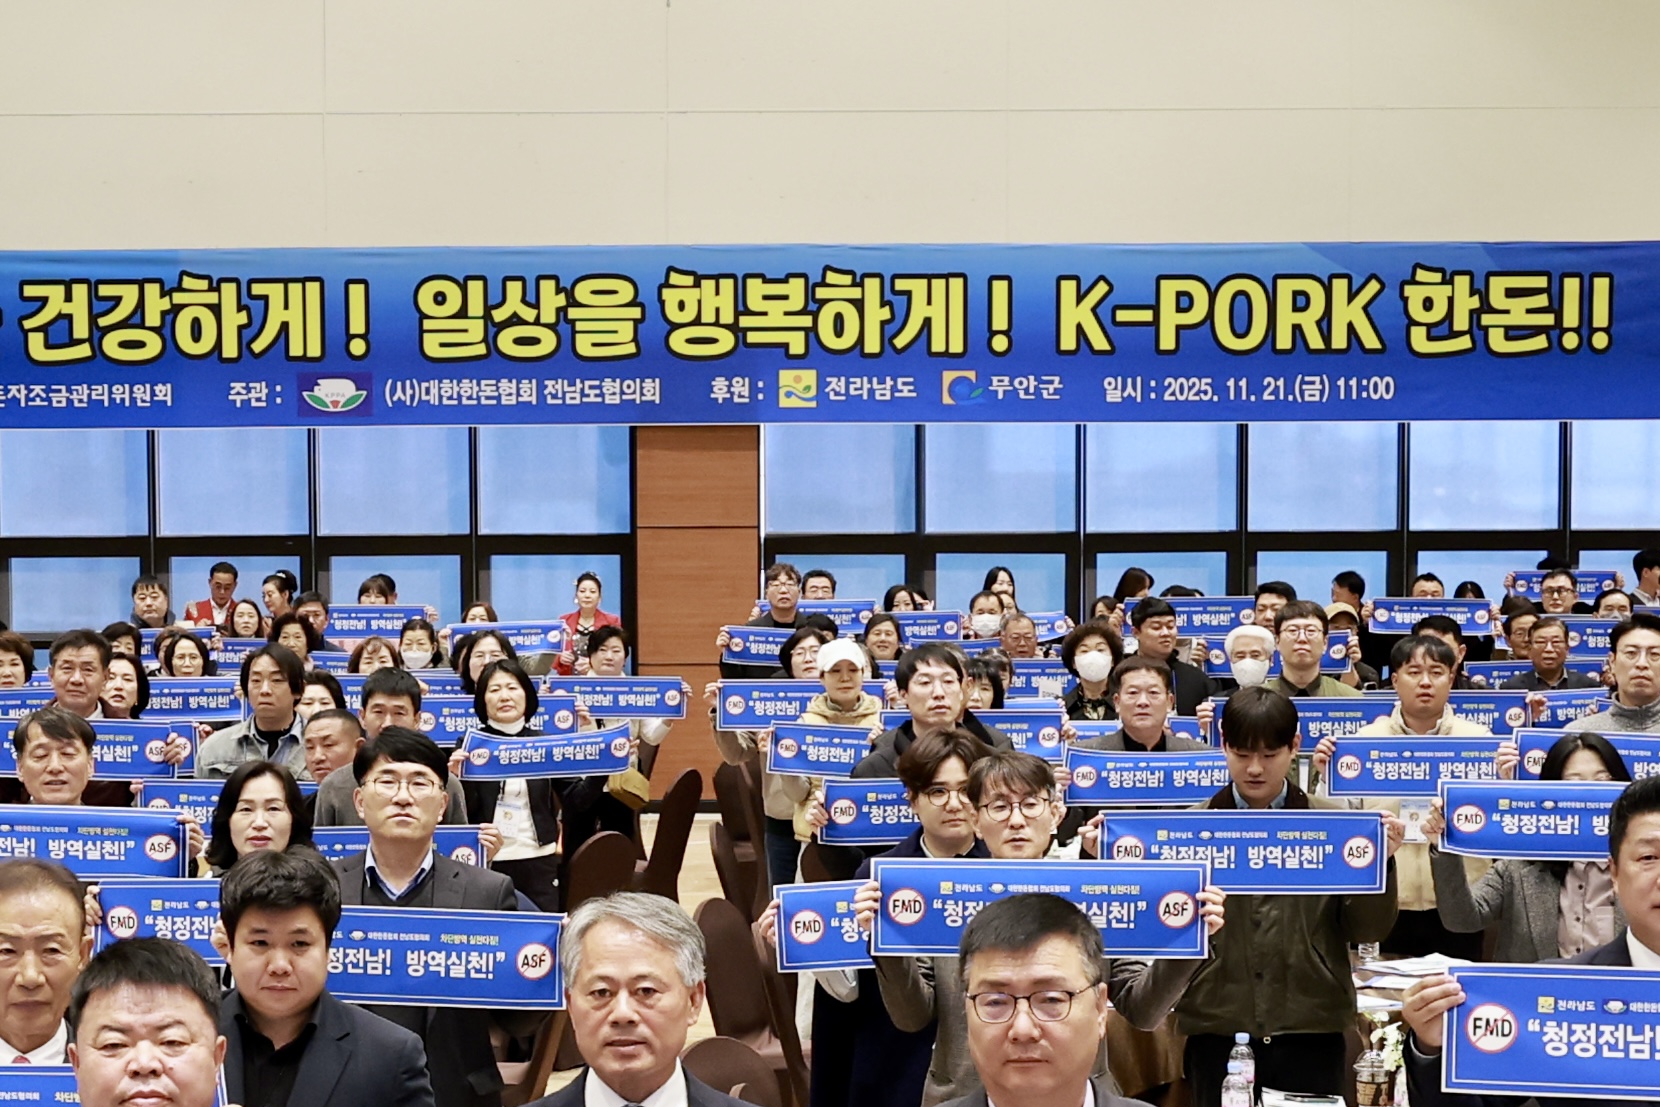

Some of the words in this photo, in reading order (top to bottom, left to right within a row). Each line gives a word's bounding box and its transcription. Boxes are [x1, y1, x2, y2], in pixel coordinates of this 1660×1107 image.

[416, 276, 645, 362] 일상을
[1057, 274, 1386, 355] K-PORK
[1402, 263, 1613, 356] 한돈!!
[229, 381, 267, 406] 주관
[384, 381, 536, 407] (사)대한한돈협회
[543, 379, 660, 405] 전남도협의회
[711, 376, 749, 402] 후원
[825, 376, 916, 400] 전라남도
[988, 376, 1063, 400] 무안군
[1103, 378, 1143, 404] 일시
[1337, 377, 1395, 401] 11:00
[558, 714, 571, 725] ASF
[613, 743, 627, 752] ASF
[780, 743, 797, 753] FMD
[1339, 761, 1359, 773] FMD
[1077, 770, 1094, 782] FMD
[833, 806, 855, 819] FMD
[1457, 813, 1483, 825] FMD
[149, 841, 171, 854] ASF
[1346, 844, 1369, 859] ASF
[893, 900, 922, 915] FMD
[1163, 903, 1188, 917] ASF
[110, 915, 136, 932] FMD
[795, 920, 822, 936] FMD
[328, 945, 391, 977] 정전남!
[521, 952, 548, 968] ASF
[1557, 1000, 1595, 1012] 전라남도
[1474, 1018, 1512, 1037] FMD
